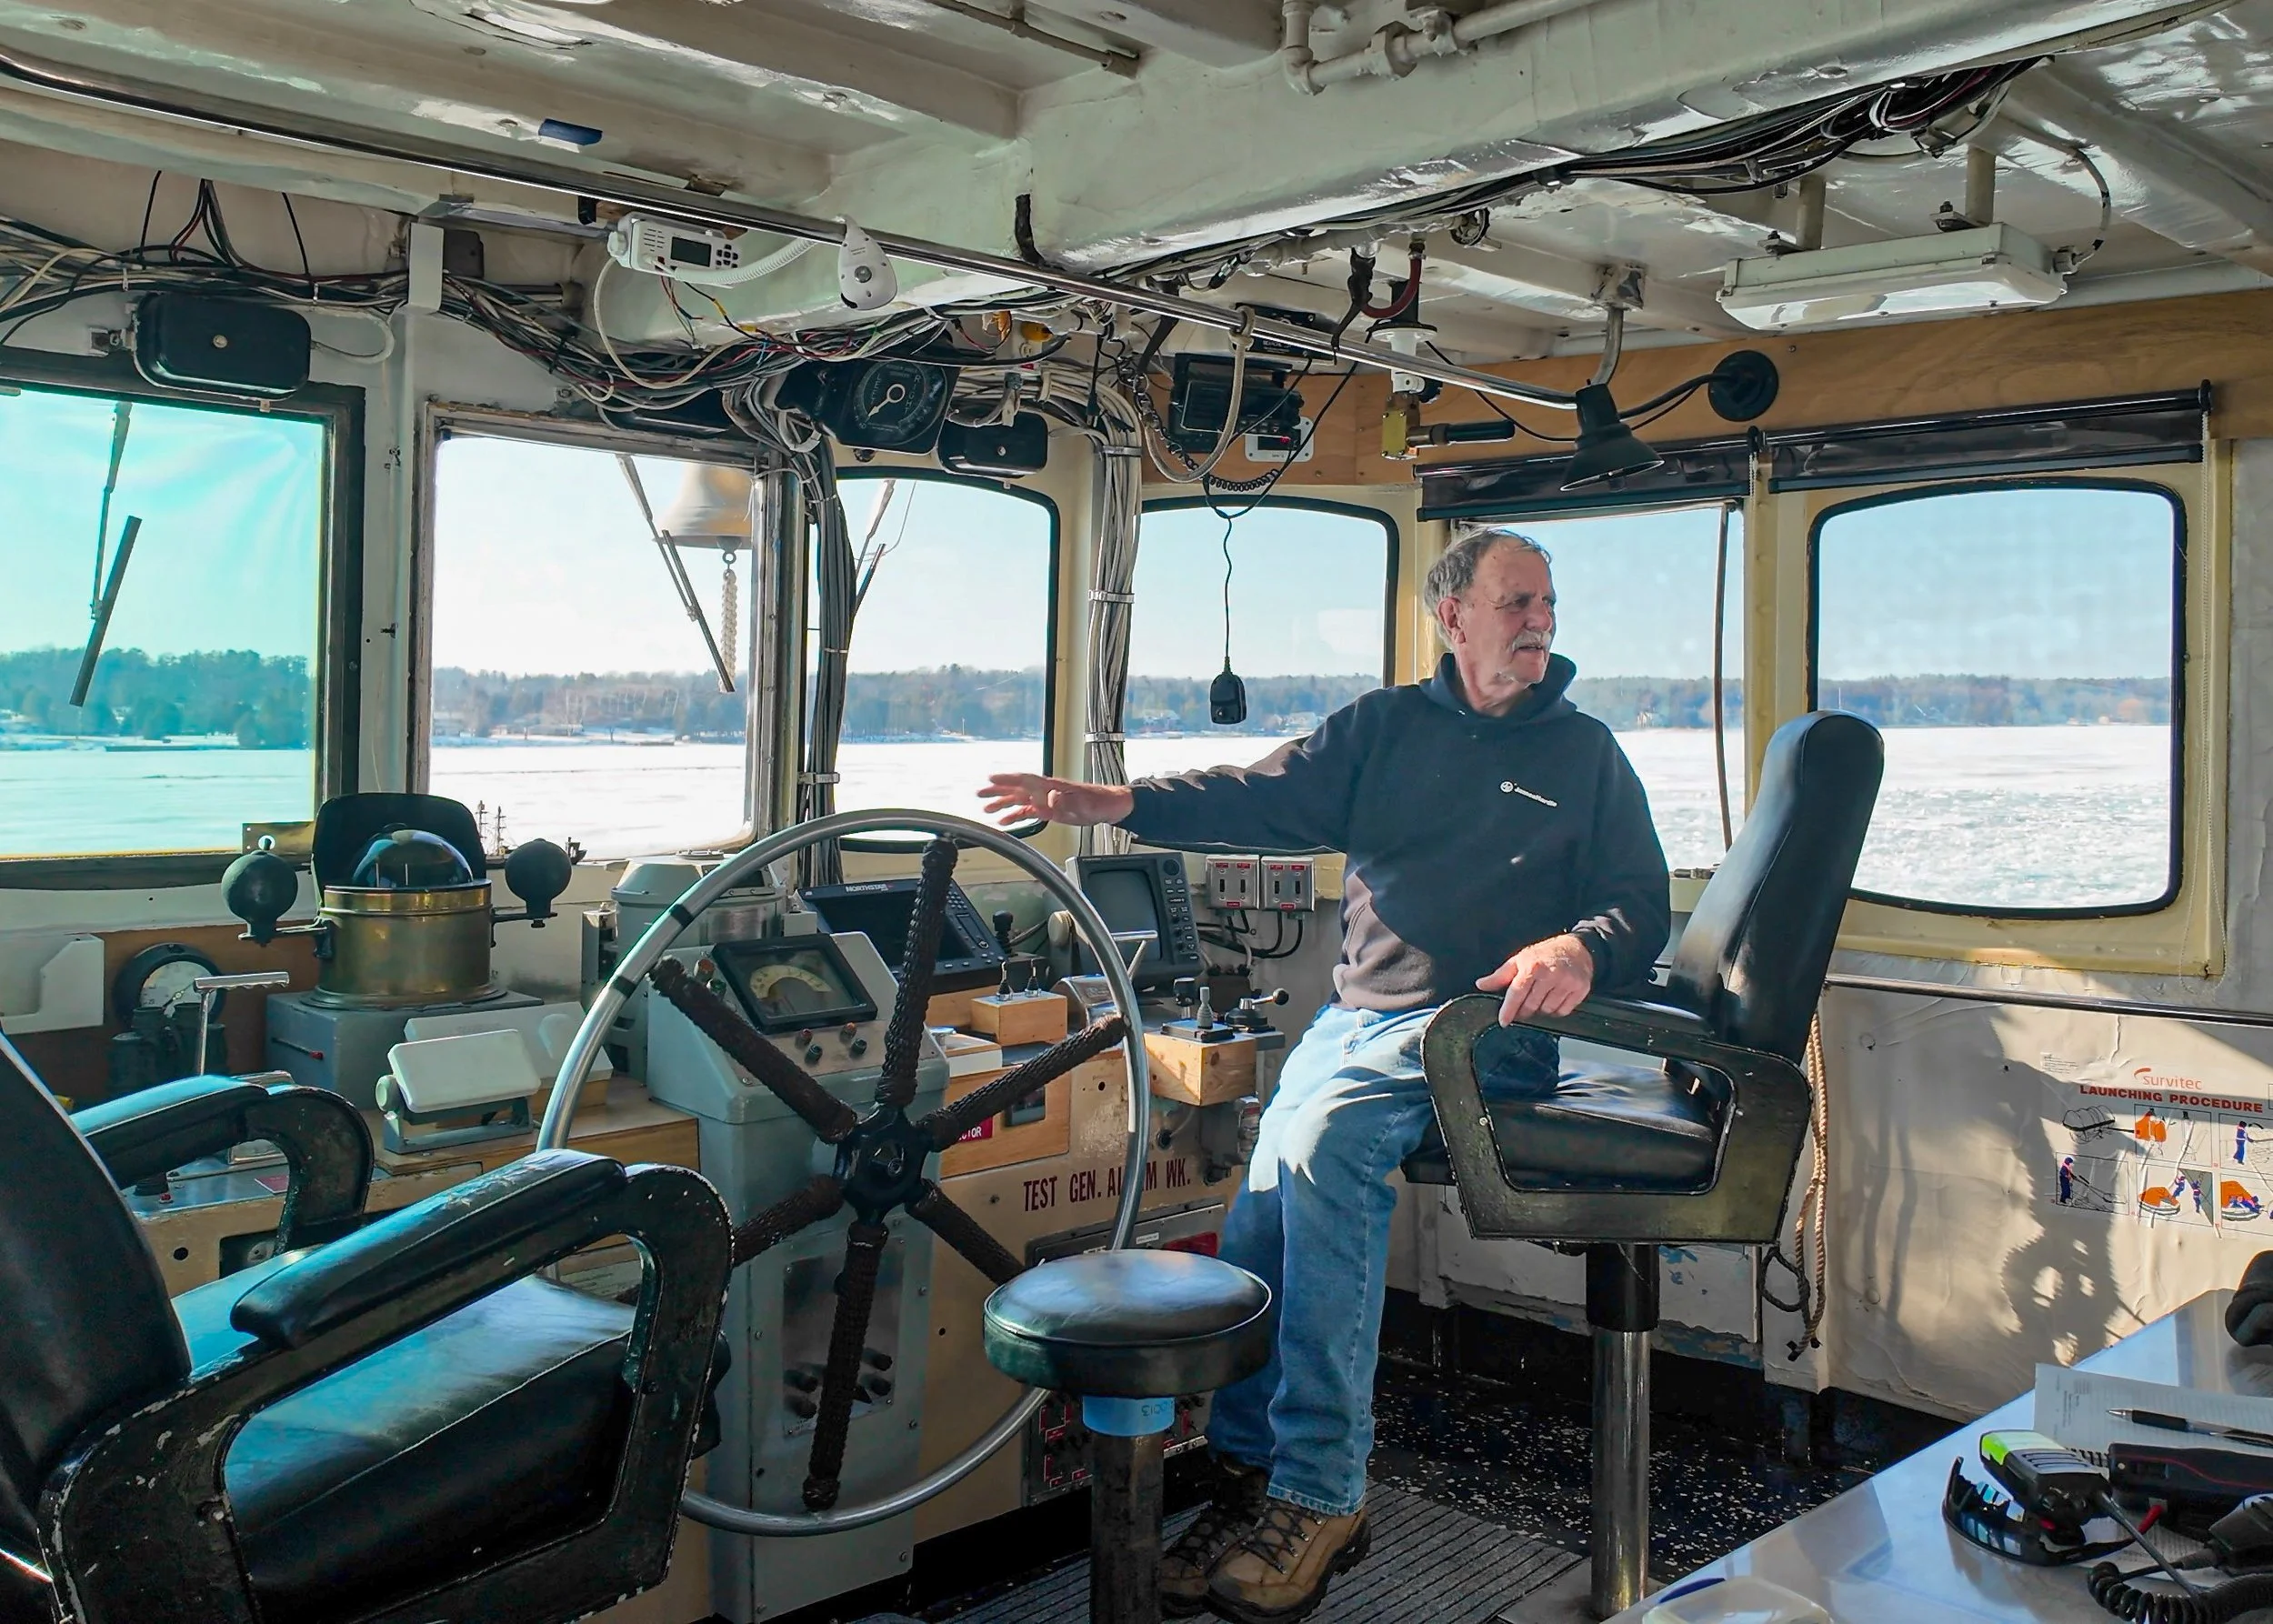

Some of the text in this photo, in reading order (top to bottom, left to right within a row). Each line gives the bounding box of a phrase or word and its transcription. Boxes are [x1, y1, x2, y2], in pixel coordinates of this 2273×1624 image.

[904, 374, 923, 416] RIGHT
[846, 883, 888, 892] NORTHSTAR
[2143, 1074, 2202, 1090] survitec
[2080, 1085, 2263, 1113] LAUNCHING PROCEDURE
[1024, 1176, 1057, 1212] TEST
[1069, 1169, 1101, 1203] GEN.
[1167, 1158, 1191, 1188] WK.
